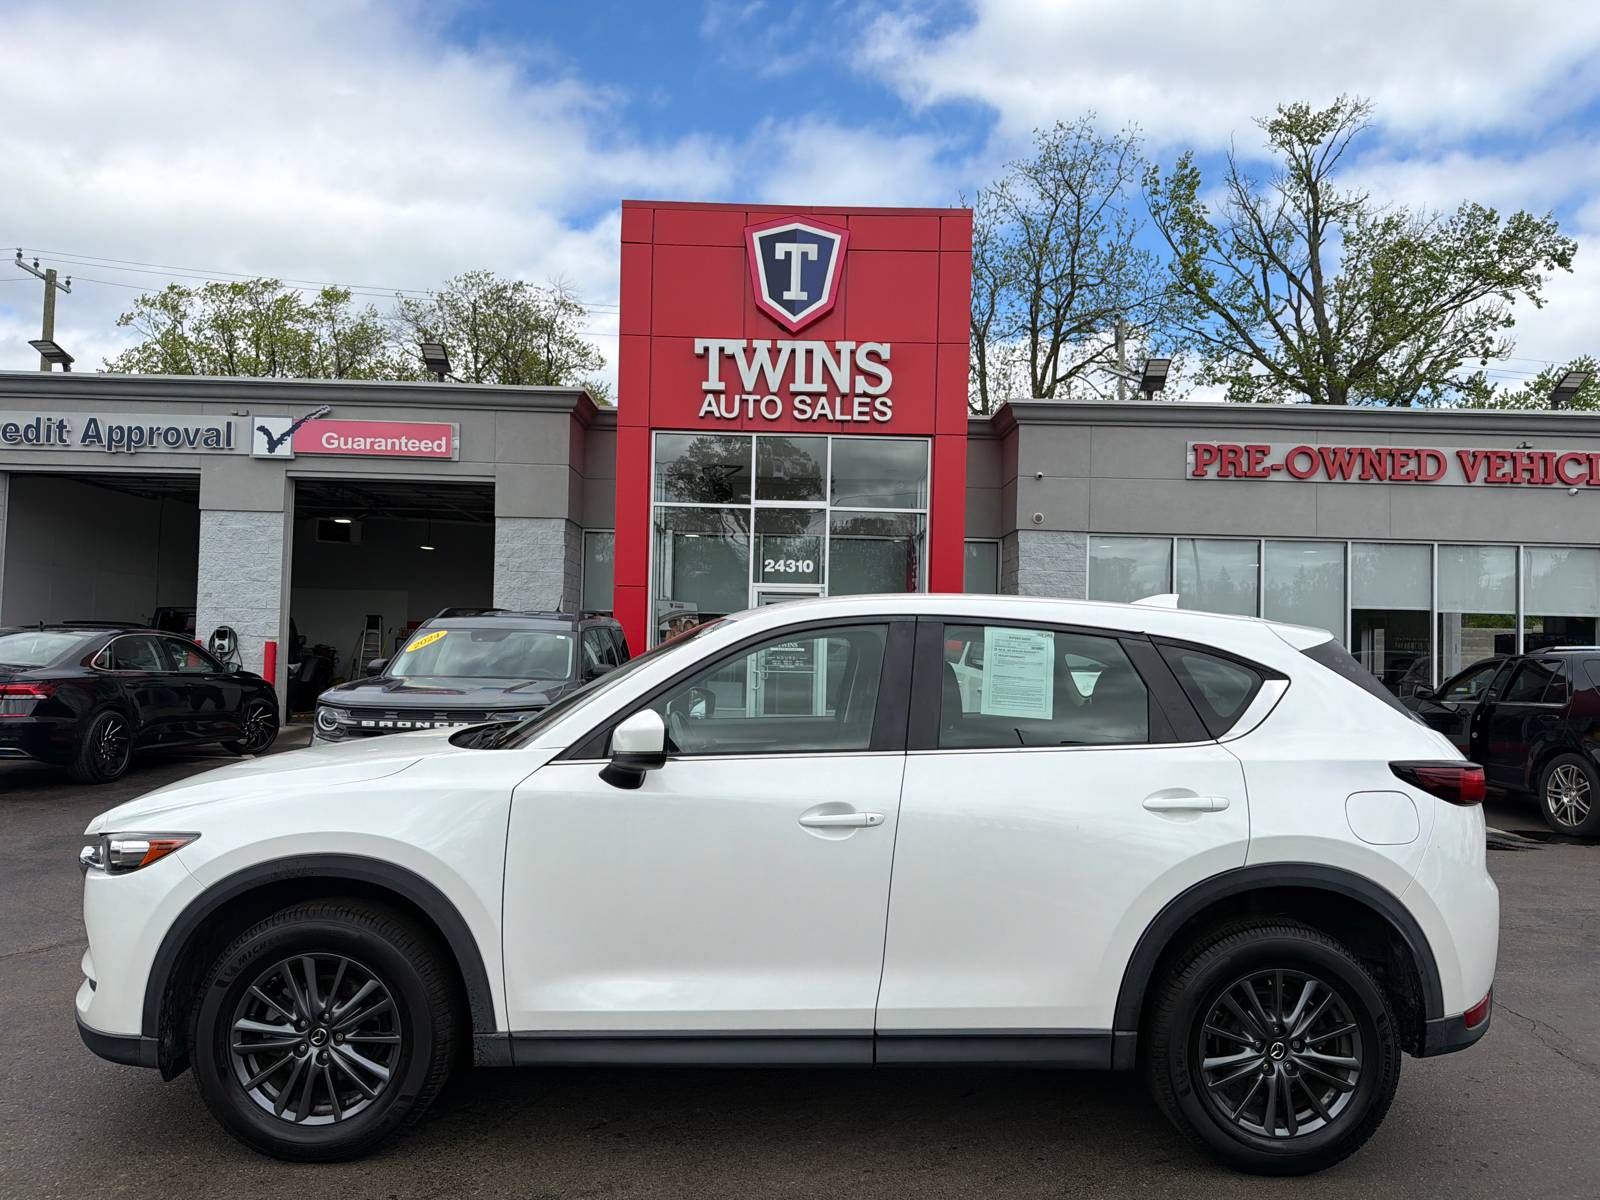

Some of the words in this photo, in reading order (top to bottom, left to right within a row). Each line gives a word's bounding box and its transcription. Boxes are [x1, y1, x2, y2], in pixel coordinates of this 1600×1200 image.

[775, 242, 818, 300] T
[694, 338, 893, 395] TWINS
[699, 394, 782, 419] AUTO
[793, 396, 893, 421] SALES
[0, 416, 71, 445] edit
[80, 416, 235, 454] Approval
[321, 431, 447, 453] Guaranteed
[1192, 443, 1448, 482] PRE-OWNED
[764, 559, 814, 573] 24310
[412, 632, 440, 648] 2024
